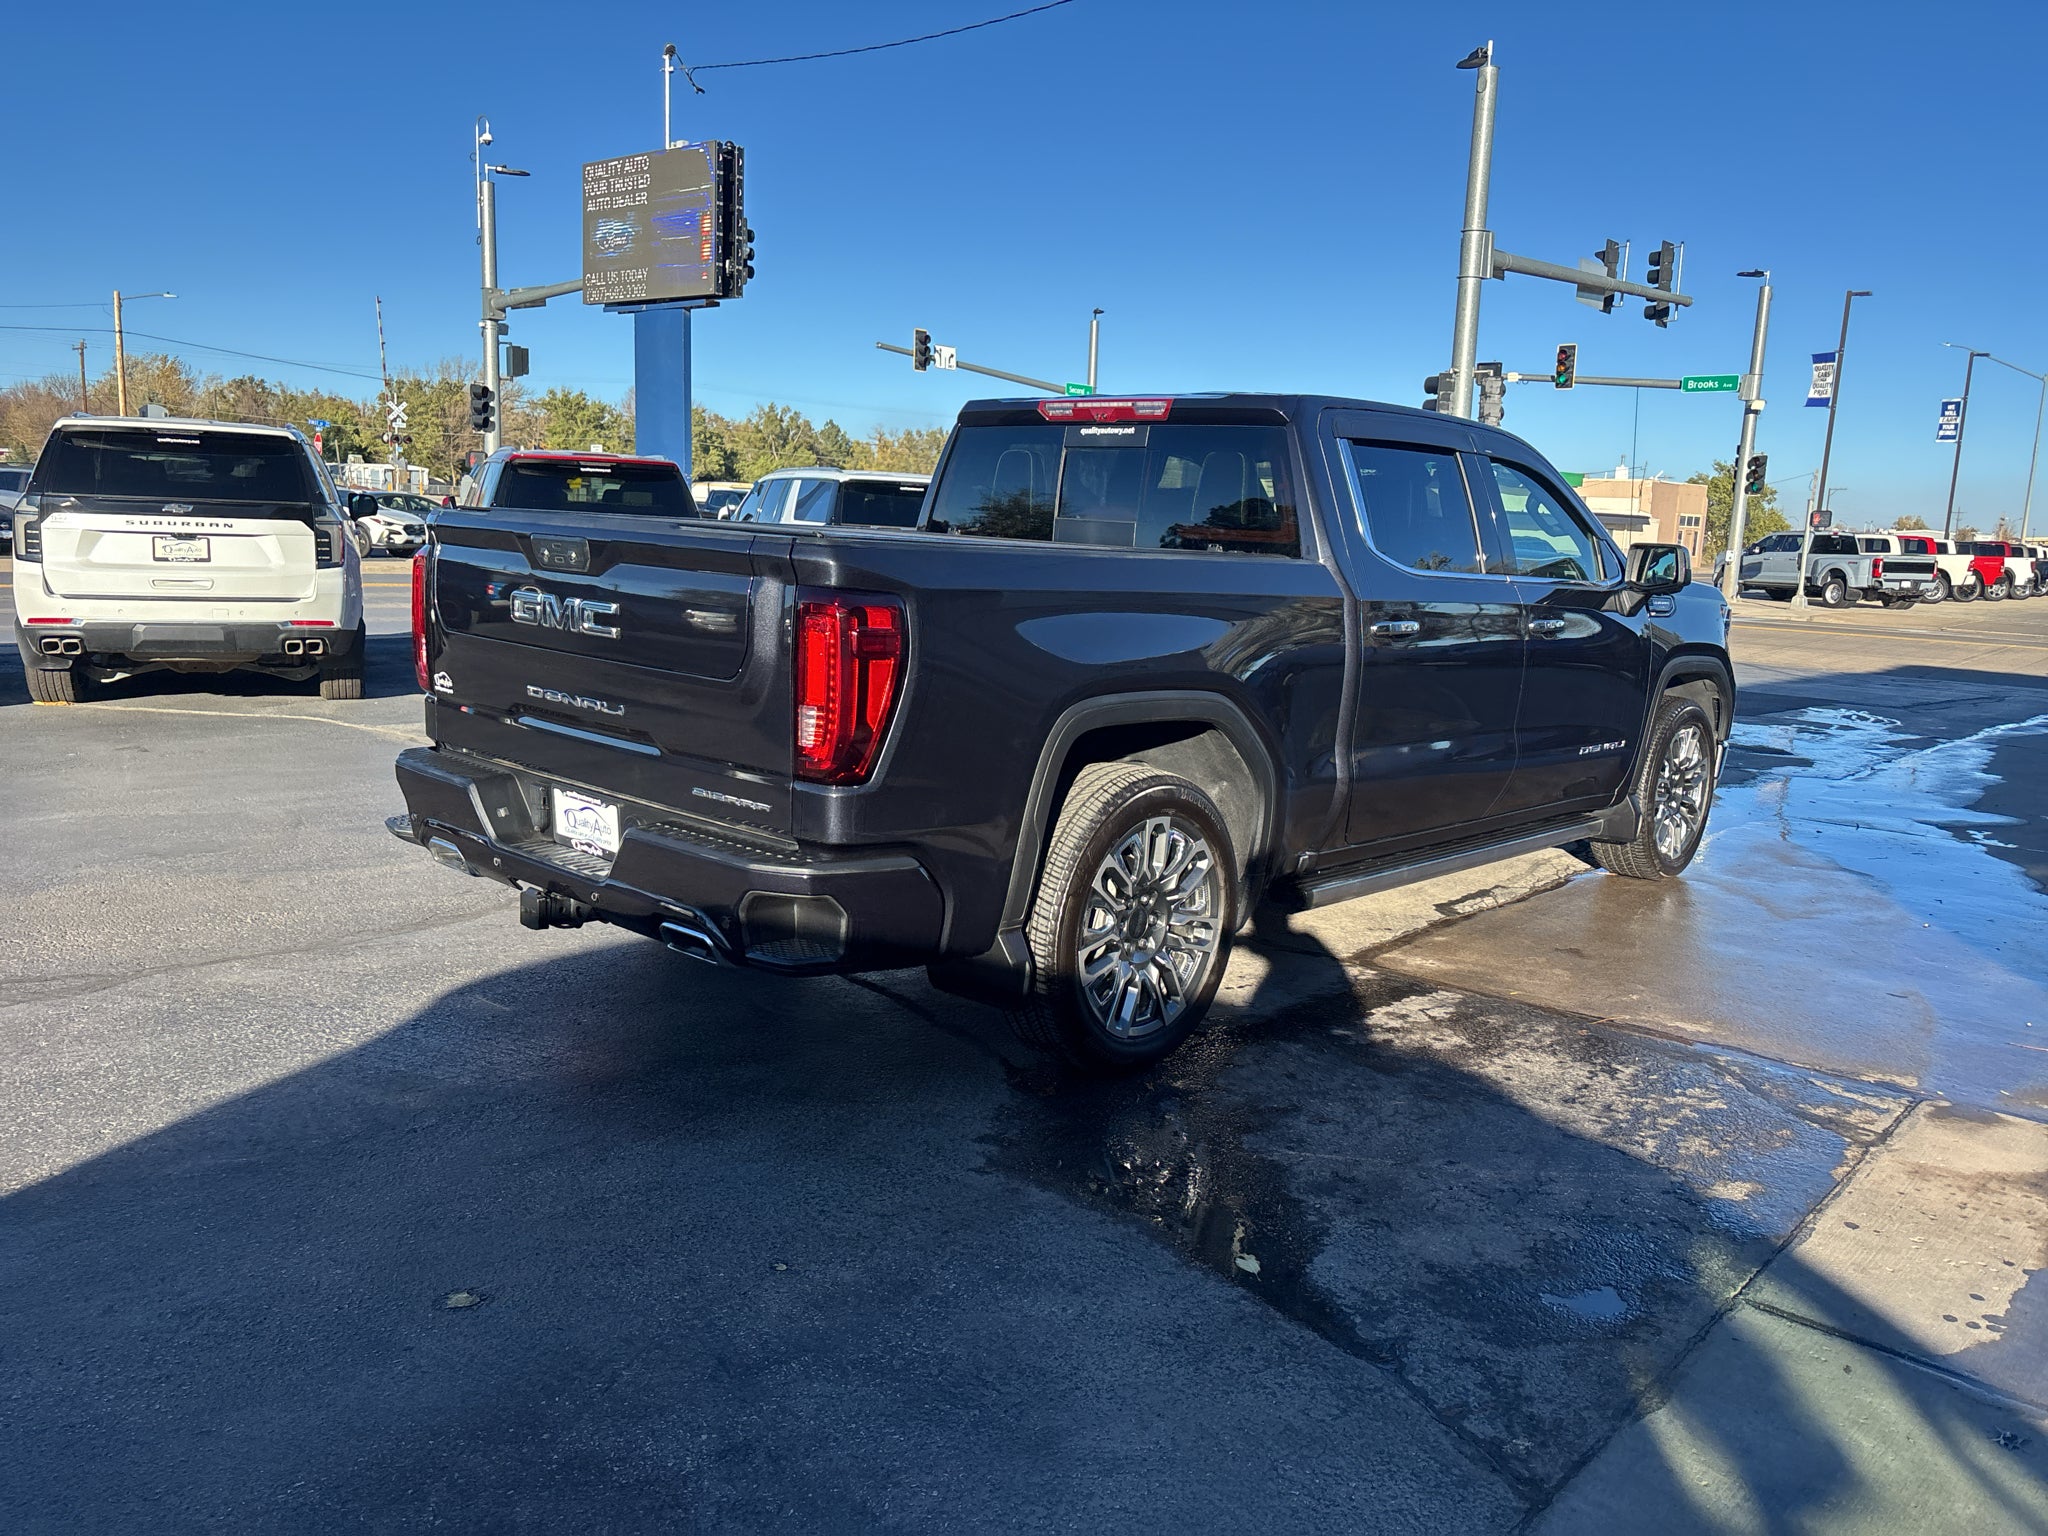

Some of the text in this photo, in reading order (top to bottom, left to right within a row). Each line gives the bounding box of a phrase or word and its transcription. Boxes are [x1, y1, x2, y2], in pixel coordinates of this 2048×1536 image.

[585, 155, 650, 181] QUALITY AUTO
[584, 173, 651, 197] YOUR TRUSTED
[587, 192, 648, 212] AUTO DEALER
[585, 267, 649, 287] CALL US TODAY
[1687, 380, 1719, 389] Brooks
[125, 519, 235, 529] SUBURBAN
[510, 589, 622, 640] GMC
[526, 684, 625, 717] DENALI
